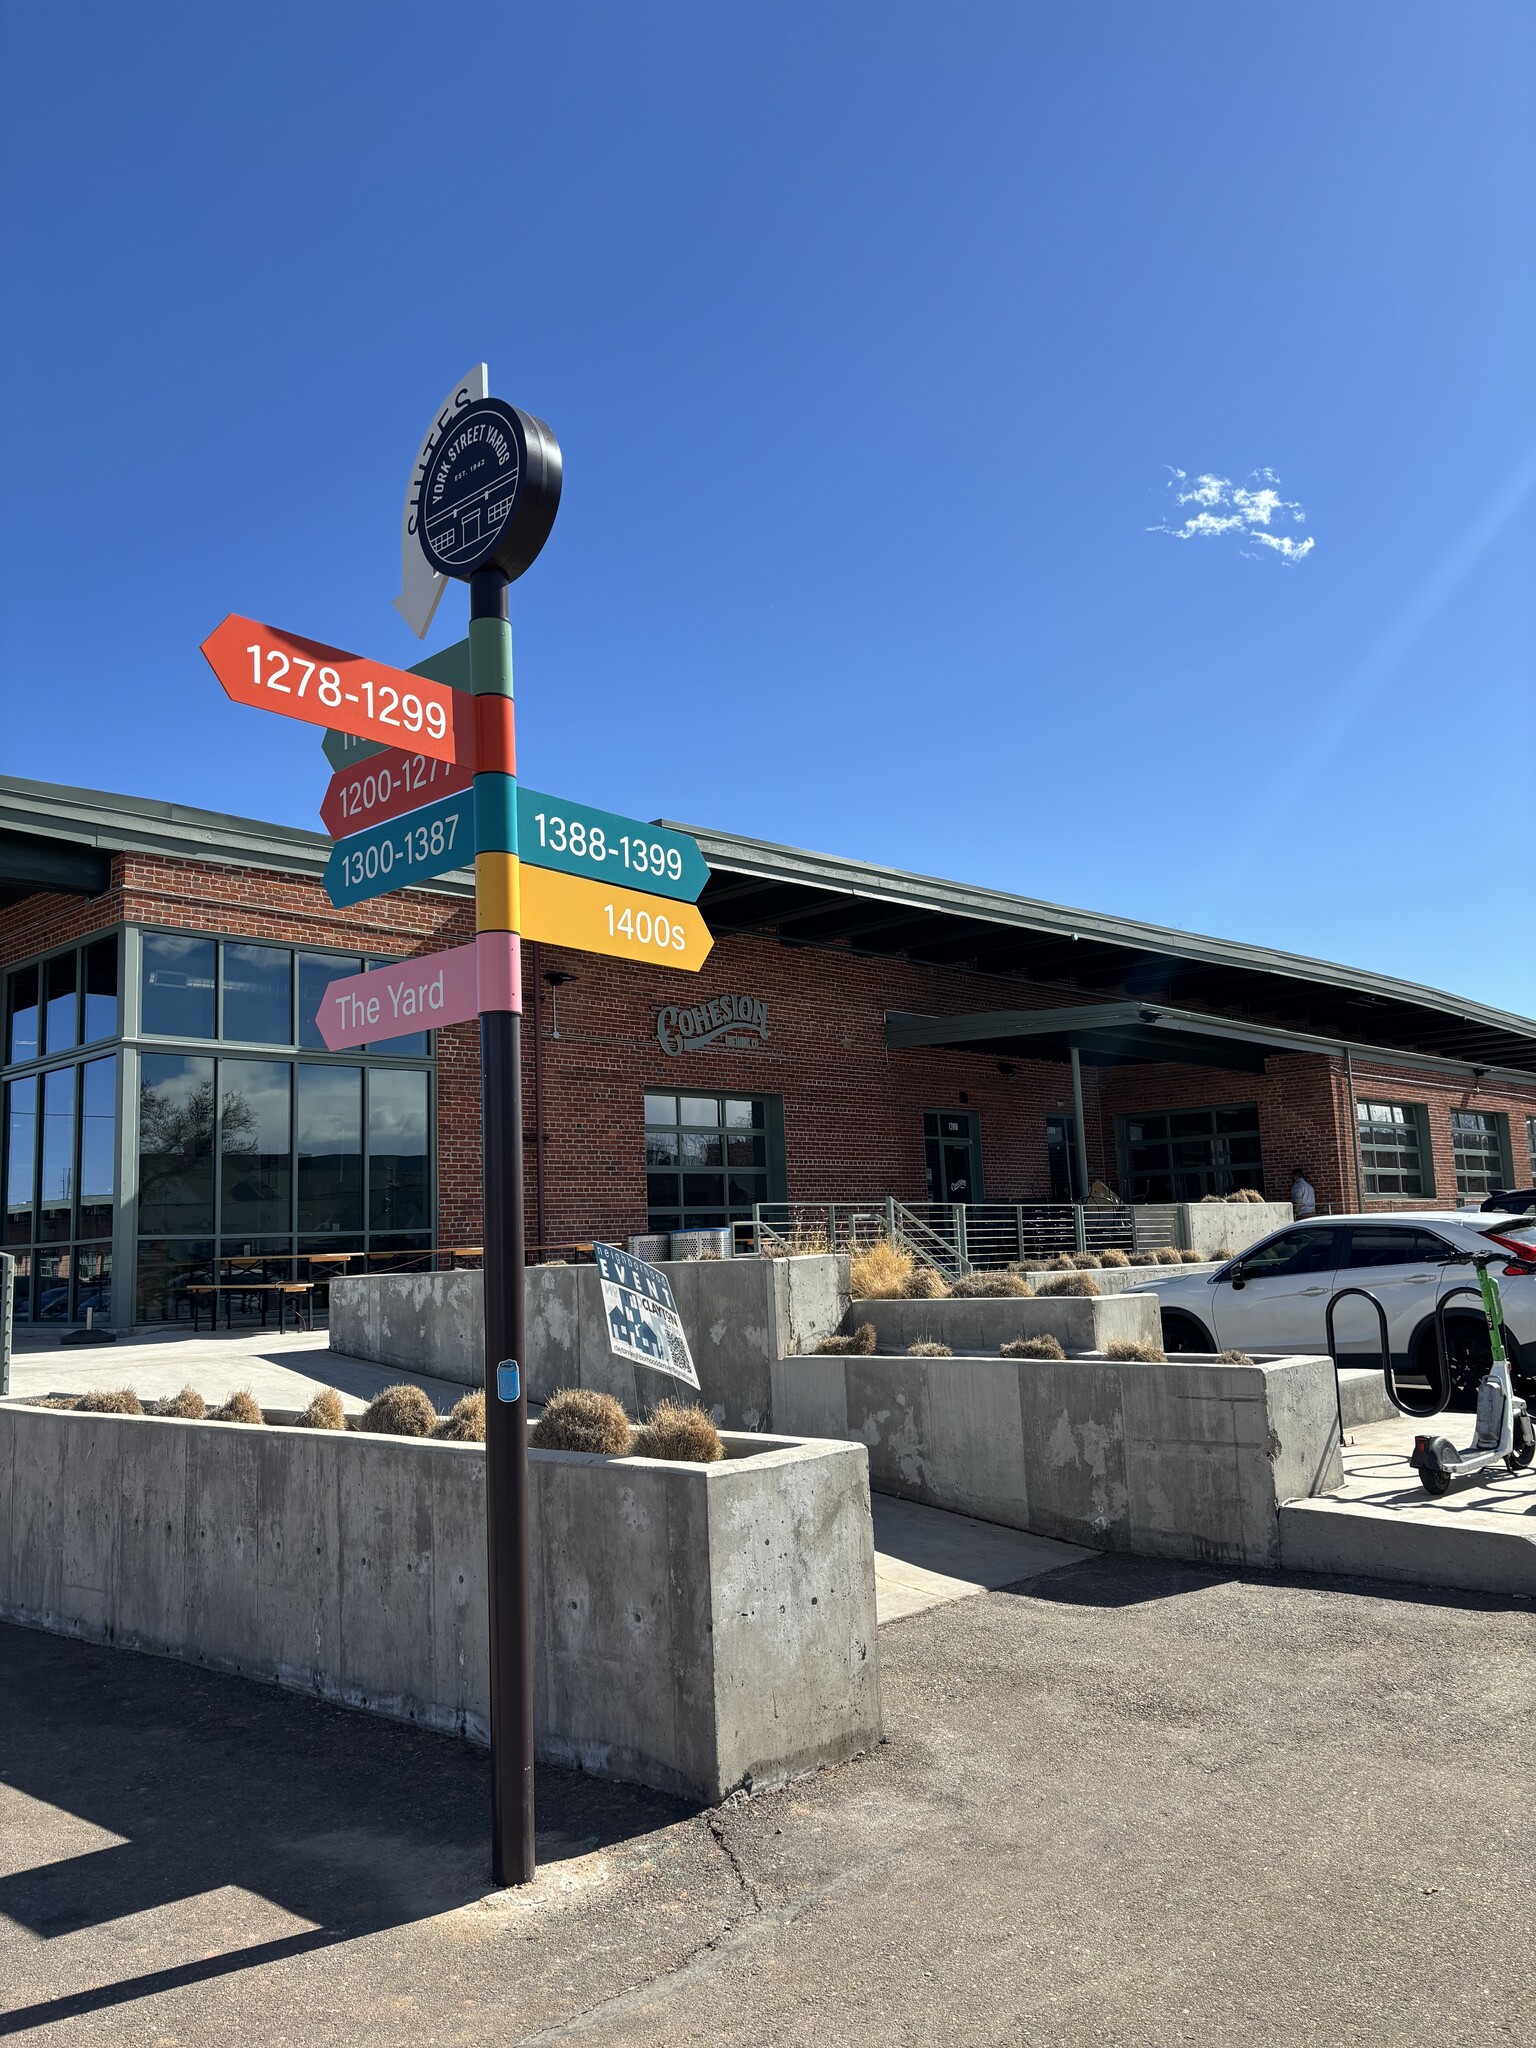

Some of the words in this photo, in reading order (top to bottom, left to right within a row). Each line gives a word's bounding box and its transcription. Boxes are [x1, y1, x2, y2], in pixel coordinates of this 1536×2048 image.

[432, 460, 452, 505] YORK
[448, 424, 487, 462] STREET
[485, 425, 511, 466] YARDS
[454, 470, 468, 482] EST.
[470, 459, 486, 472] 1942
[246, 644, 447, 740] 1278-1299
[341, 813, 459, 888] 1300-1387
[534, 803, 683, 881] 1388-1399
[603, 904, 687, 951] 1400s
[335, 992, 381, 1031] The
[386, 969, 444, 1018] Yard
[656, 994, 769, 1057] COHESION
[596, 1246, 667, 1288] neighborhood
[599, 1258, 672, 1308] EVENT
